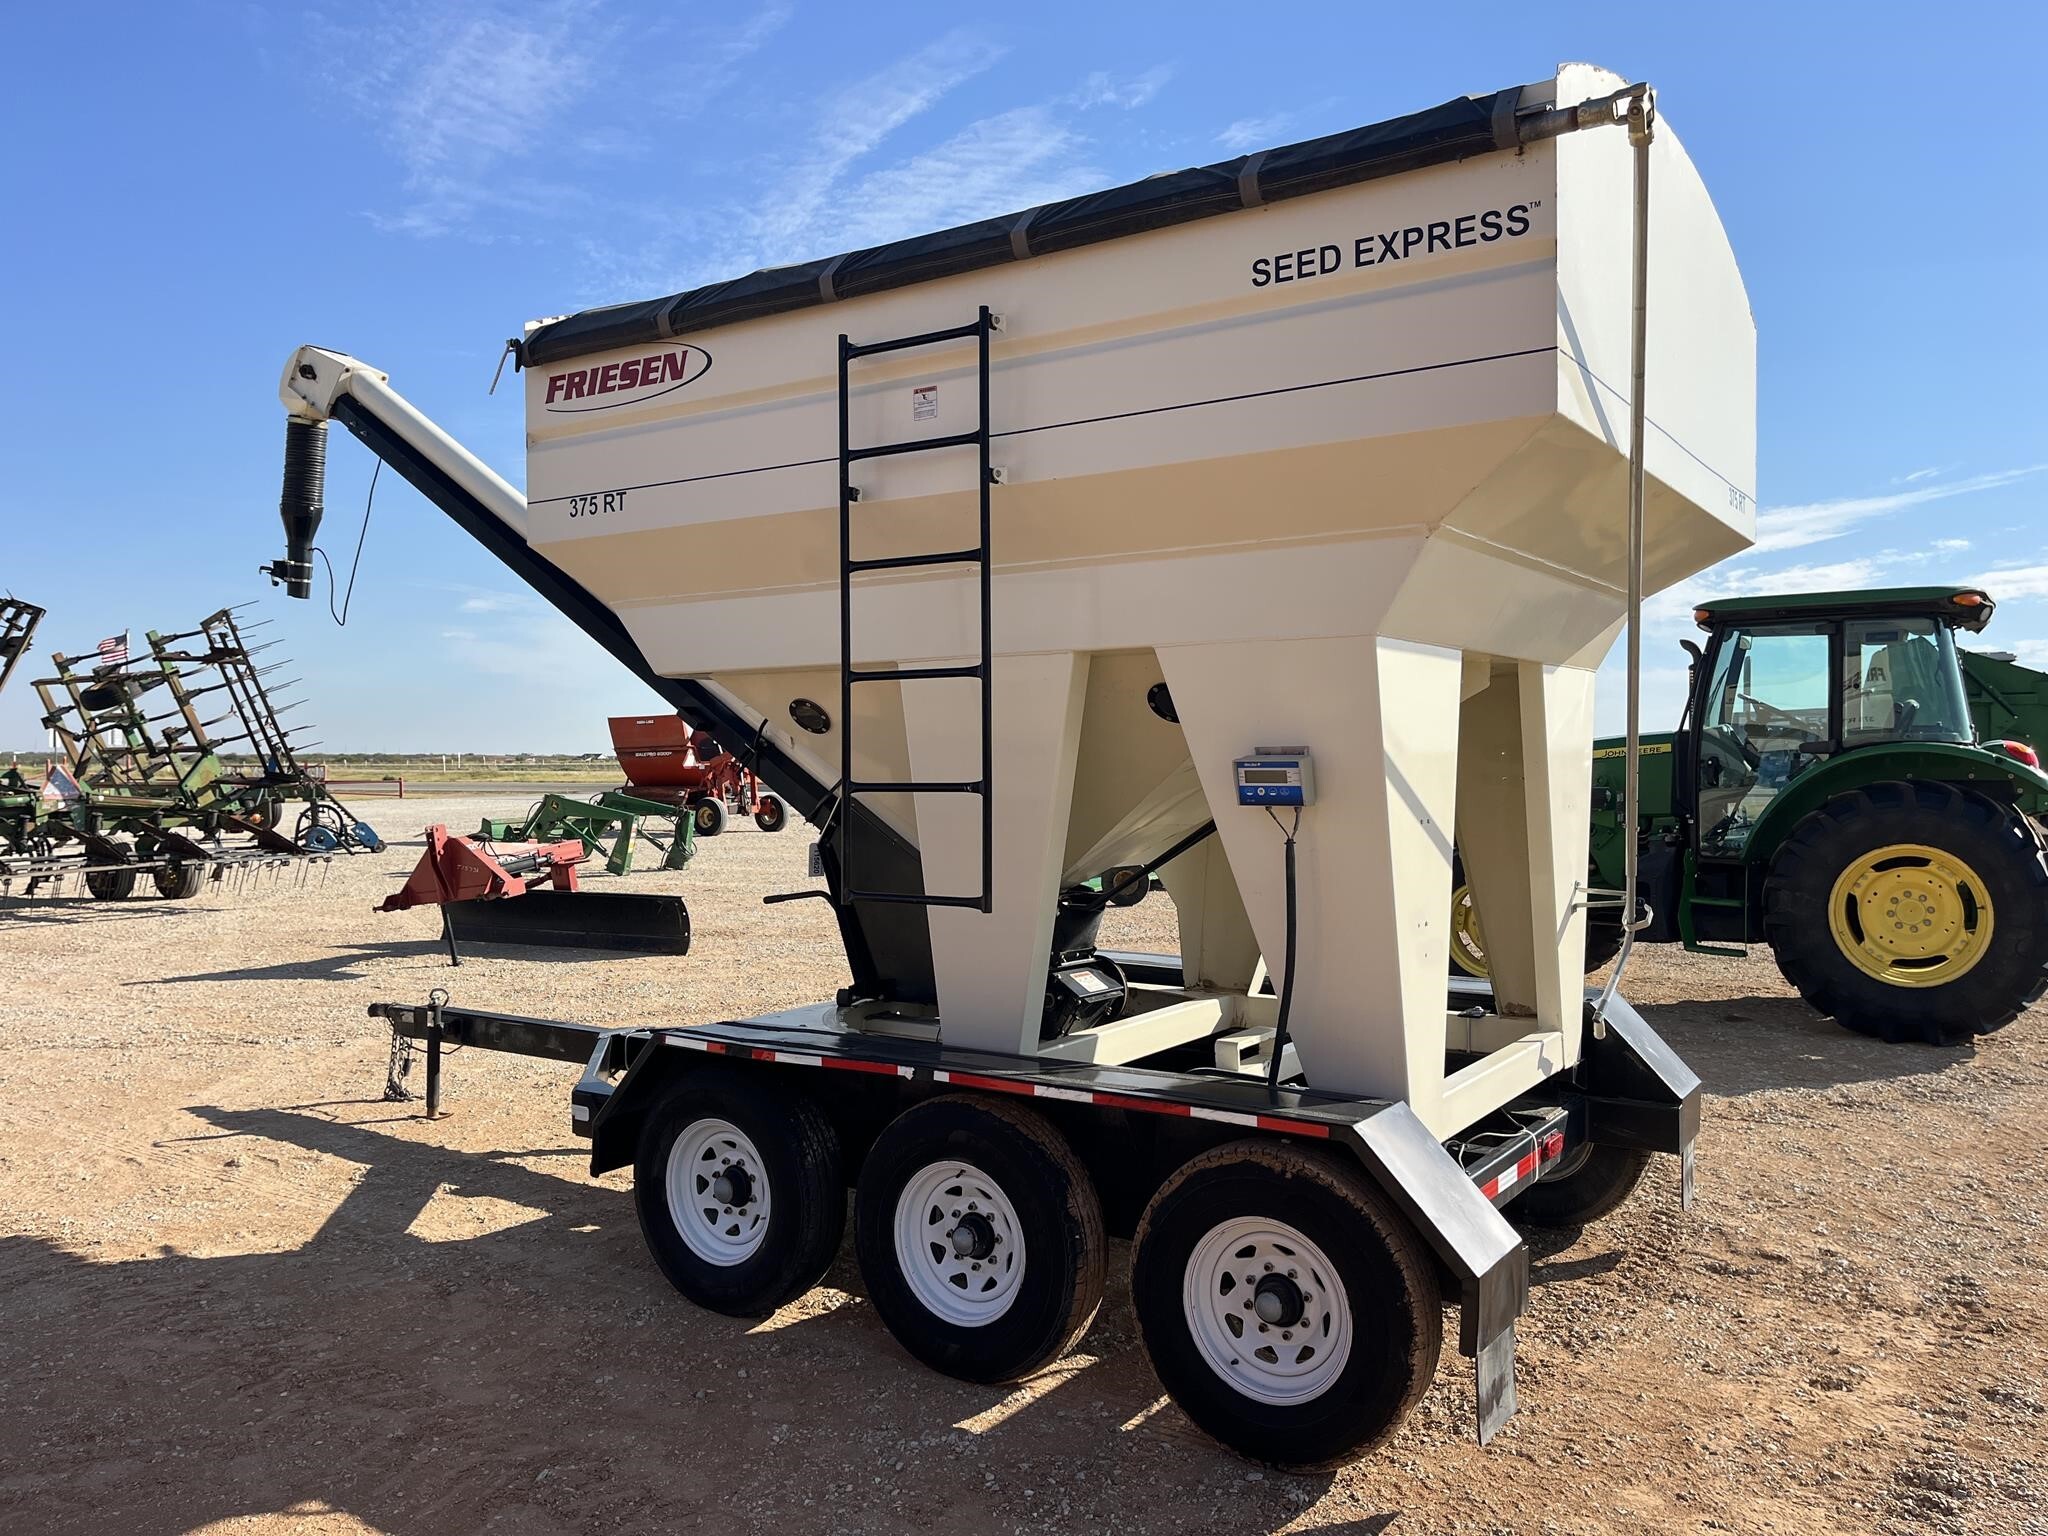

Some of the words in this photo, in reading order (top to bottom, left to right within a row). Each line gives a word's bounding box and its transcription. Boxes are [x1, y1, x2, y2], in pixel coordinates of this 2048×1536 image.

[1251, 244, 1341, 287] SEED
[545, 350, 689, 404] FRIESEN
[570, 496, 598, 518] 375
[604, 491, 627, 513] RT
[1729, 487, 1738, 510] 375
[1738, 493, 1746, 513] RT
